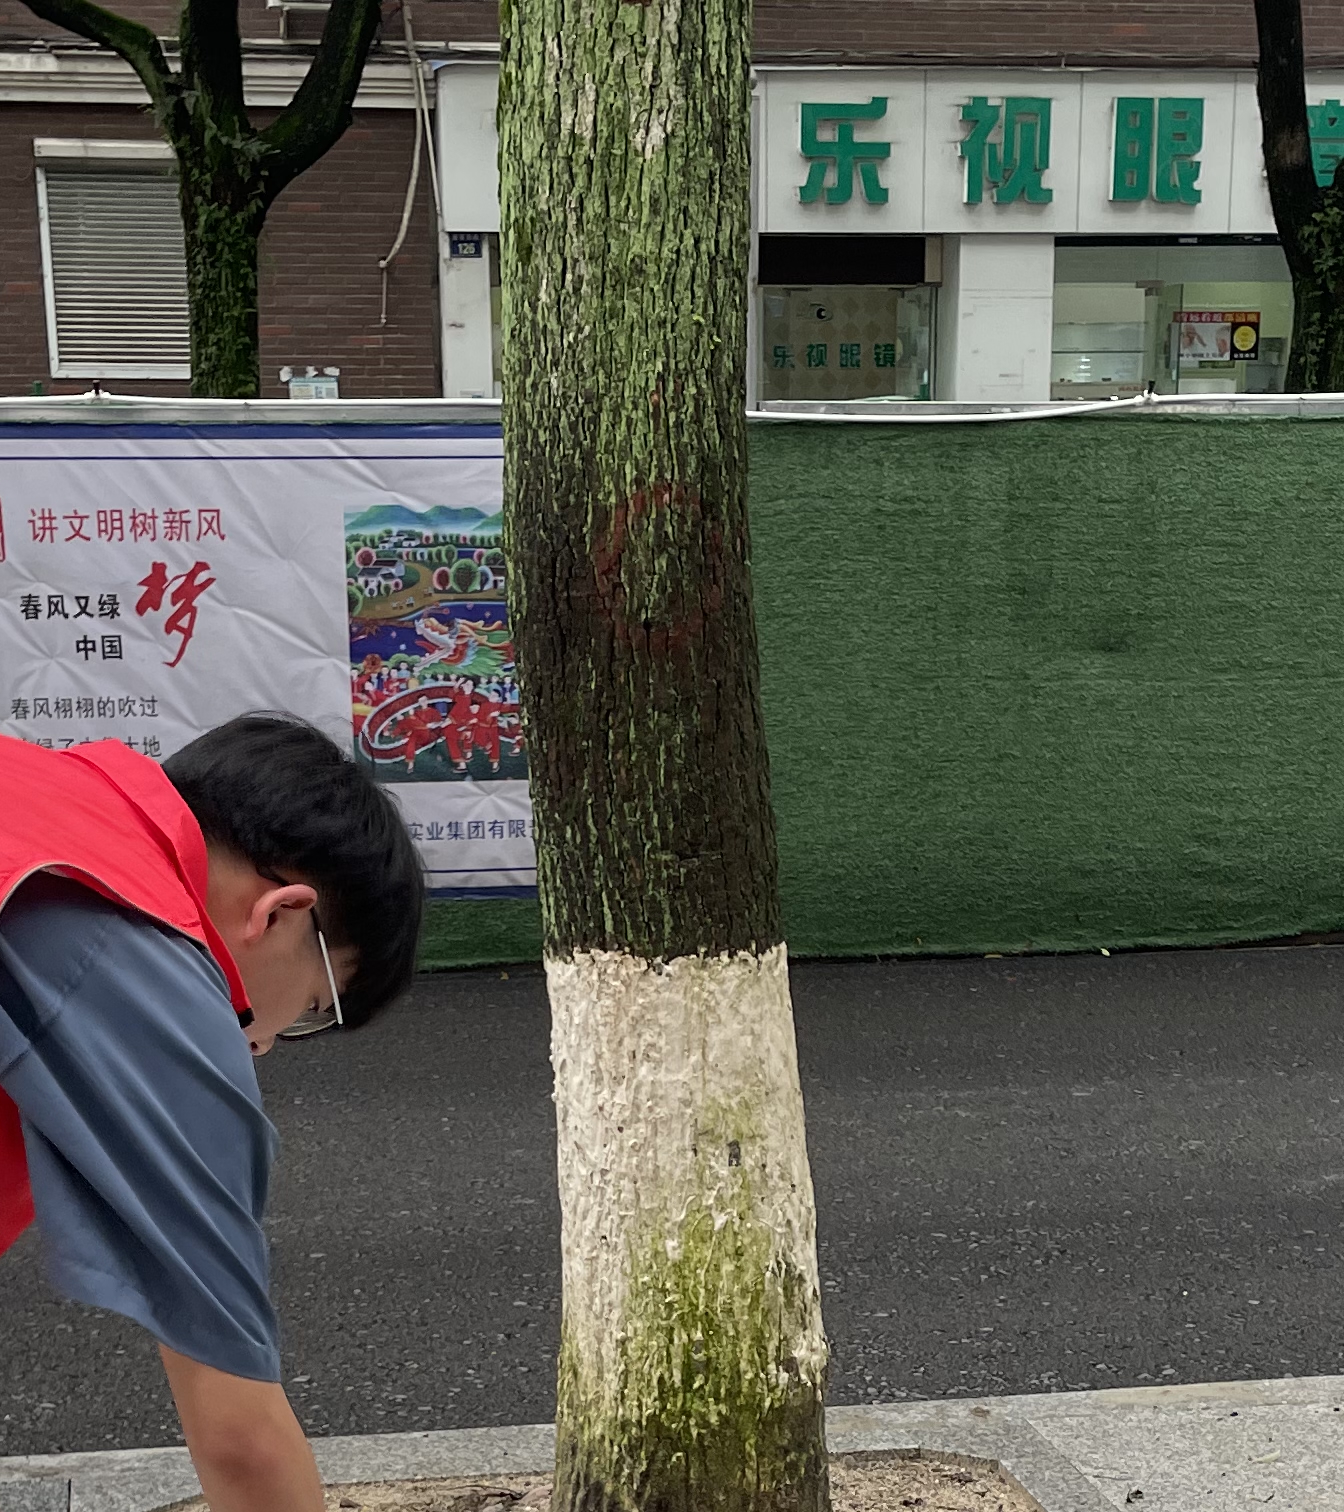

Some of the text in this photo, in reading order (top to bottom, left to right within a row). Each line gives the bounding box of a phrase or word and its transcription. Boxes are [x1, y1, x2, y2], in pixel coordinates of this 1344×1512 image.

[772, 342, 897, 369] 乐视眼镜
[27, 507, 227, 543] 讲文明树新风
[19, 593, 121, 620] 春风又绿
[75, 634, 124, 661] 中国
[10, 695, 160, 721] 春风栩栩的吹过
